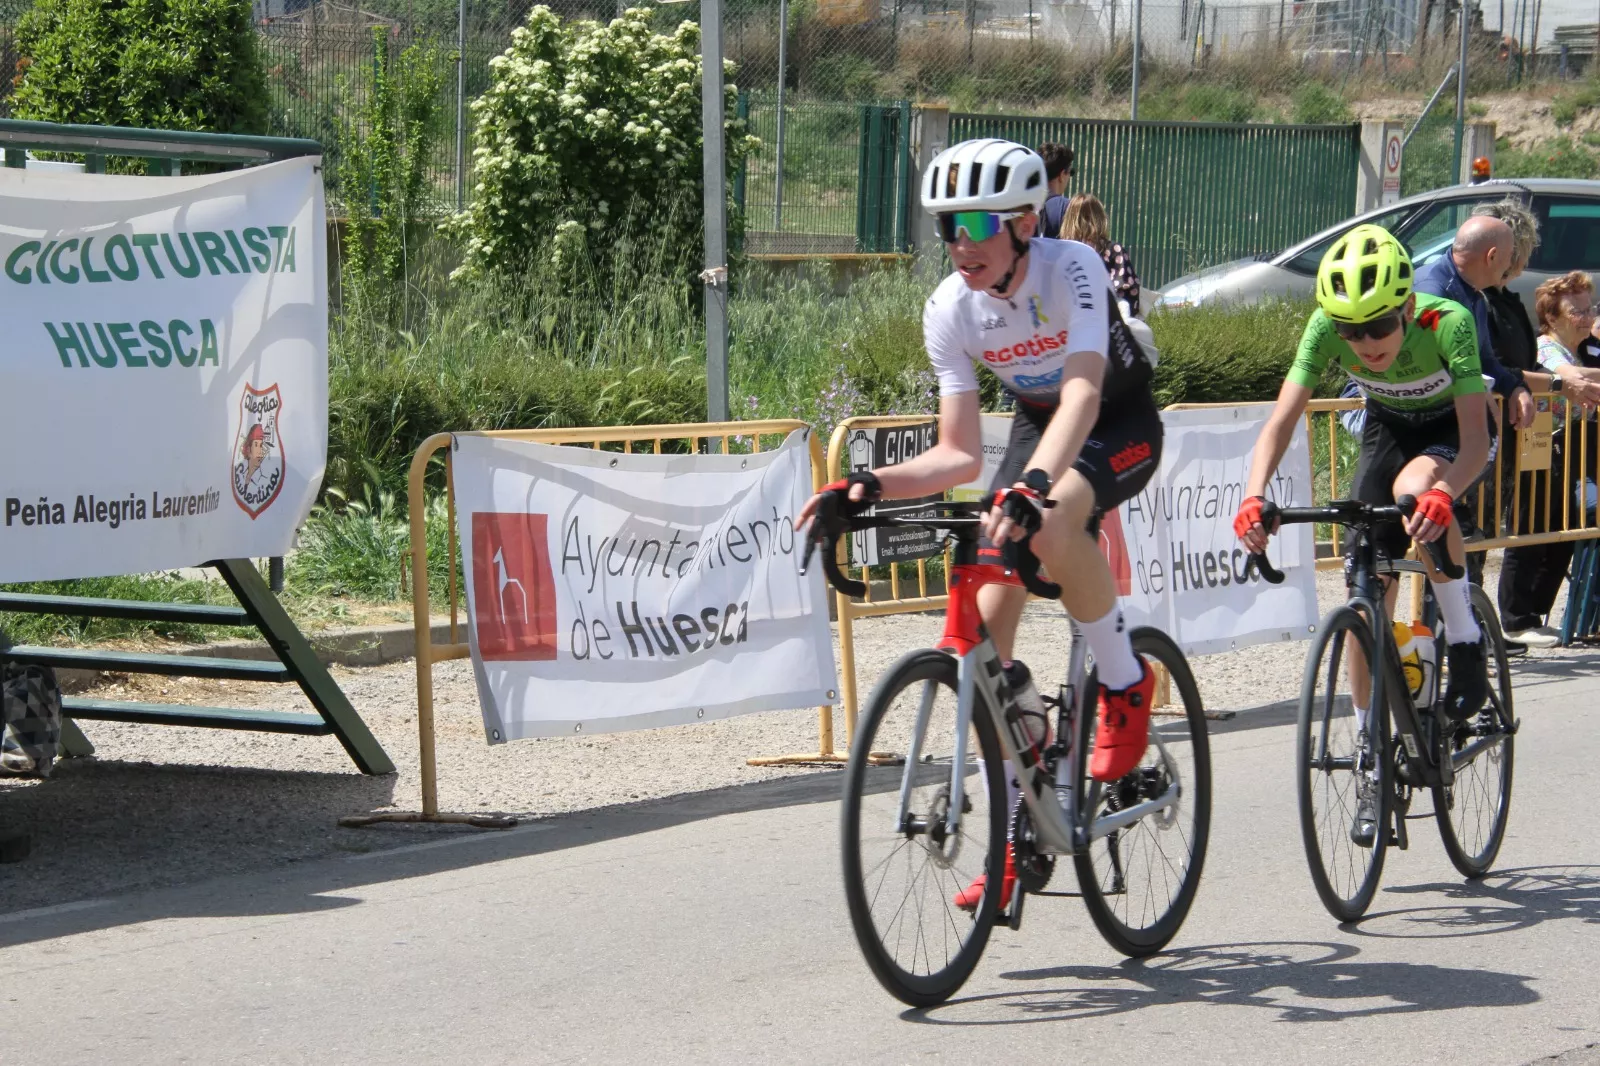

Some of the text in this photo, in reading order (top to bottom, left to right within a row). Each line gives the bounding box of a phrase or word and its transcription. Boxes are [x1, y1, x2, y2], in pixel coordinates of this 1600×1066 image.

[5, 226, 297, 285] CICLOTURISTA
[43, 319, 219, 369] HUESCA
[886, 427, 933, 465] CICLOS
[6, 487, 220, 529] Peña Alegria Laurentina
[1137, 544, 1164, 595] de
[571, 601, 749, 660] de Huesca
